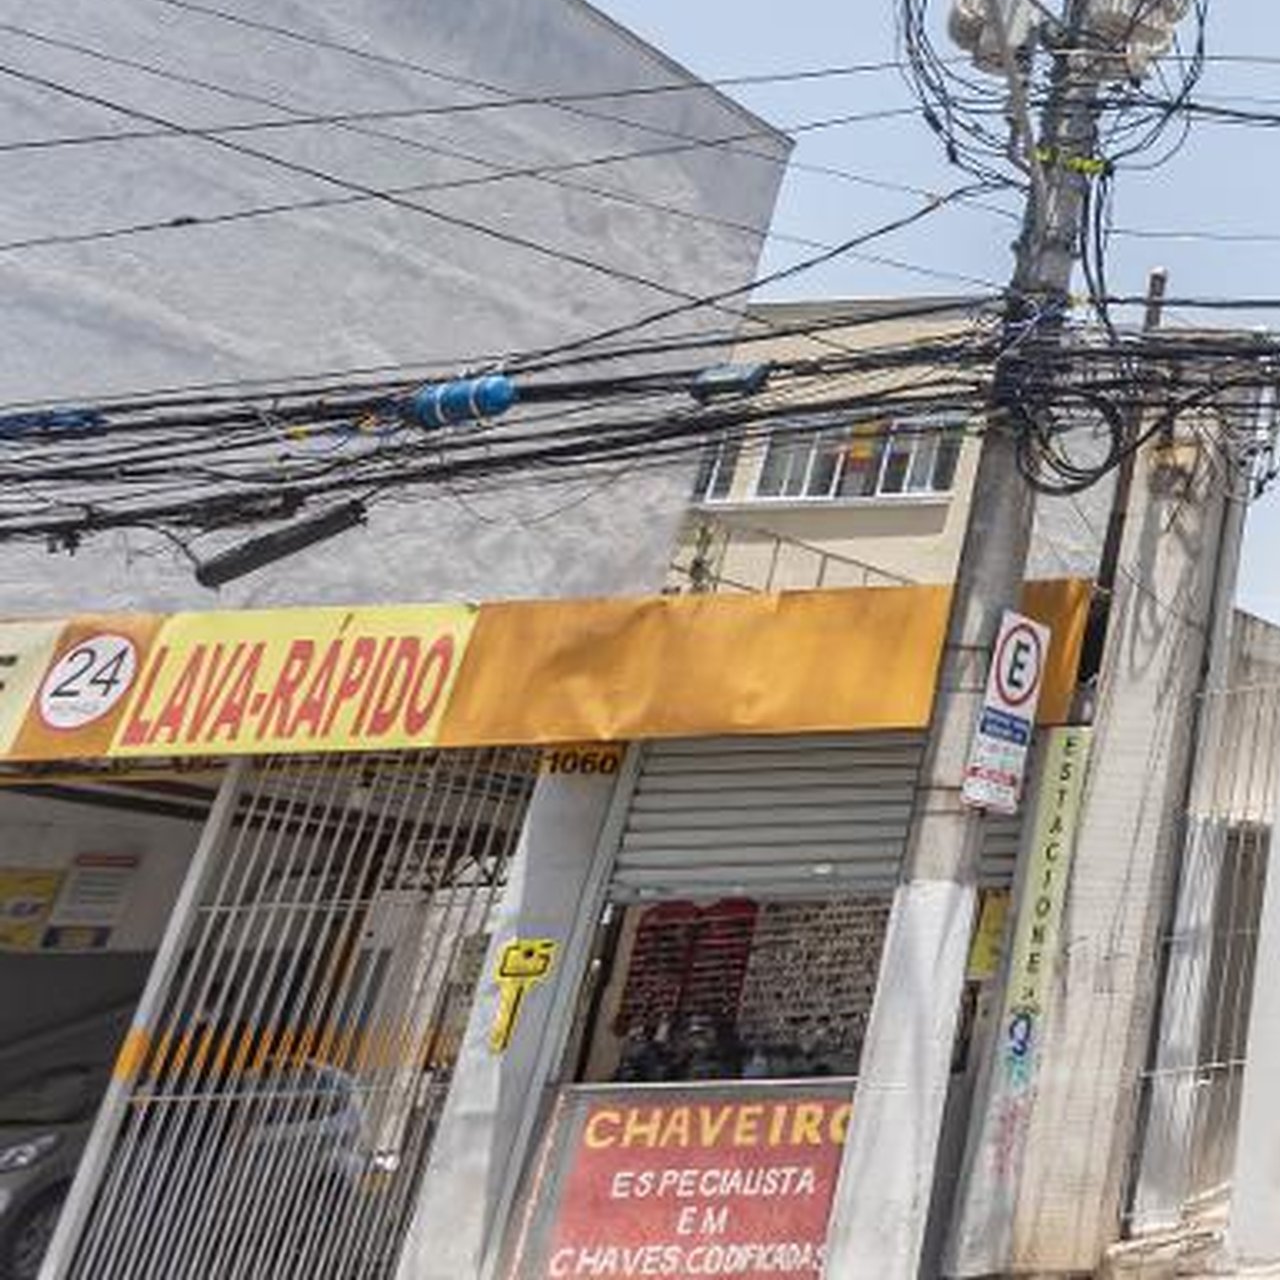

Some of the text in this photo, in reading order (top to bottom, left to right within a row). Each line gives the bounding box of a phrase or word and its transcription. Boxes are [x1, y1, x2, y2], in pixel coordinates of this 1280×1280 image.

[49, 646, 129, 698] 24
[119, 613, 456, 748] LAVA-RÁPIDO
[1008, 638, 1031, 689] E
[545, 749, 618, 775] 1060
[609, 1165, 816, 1199] ESPECIALISTA
[675, 1205, 729, 1236] EM
